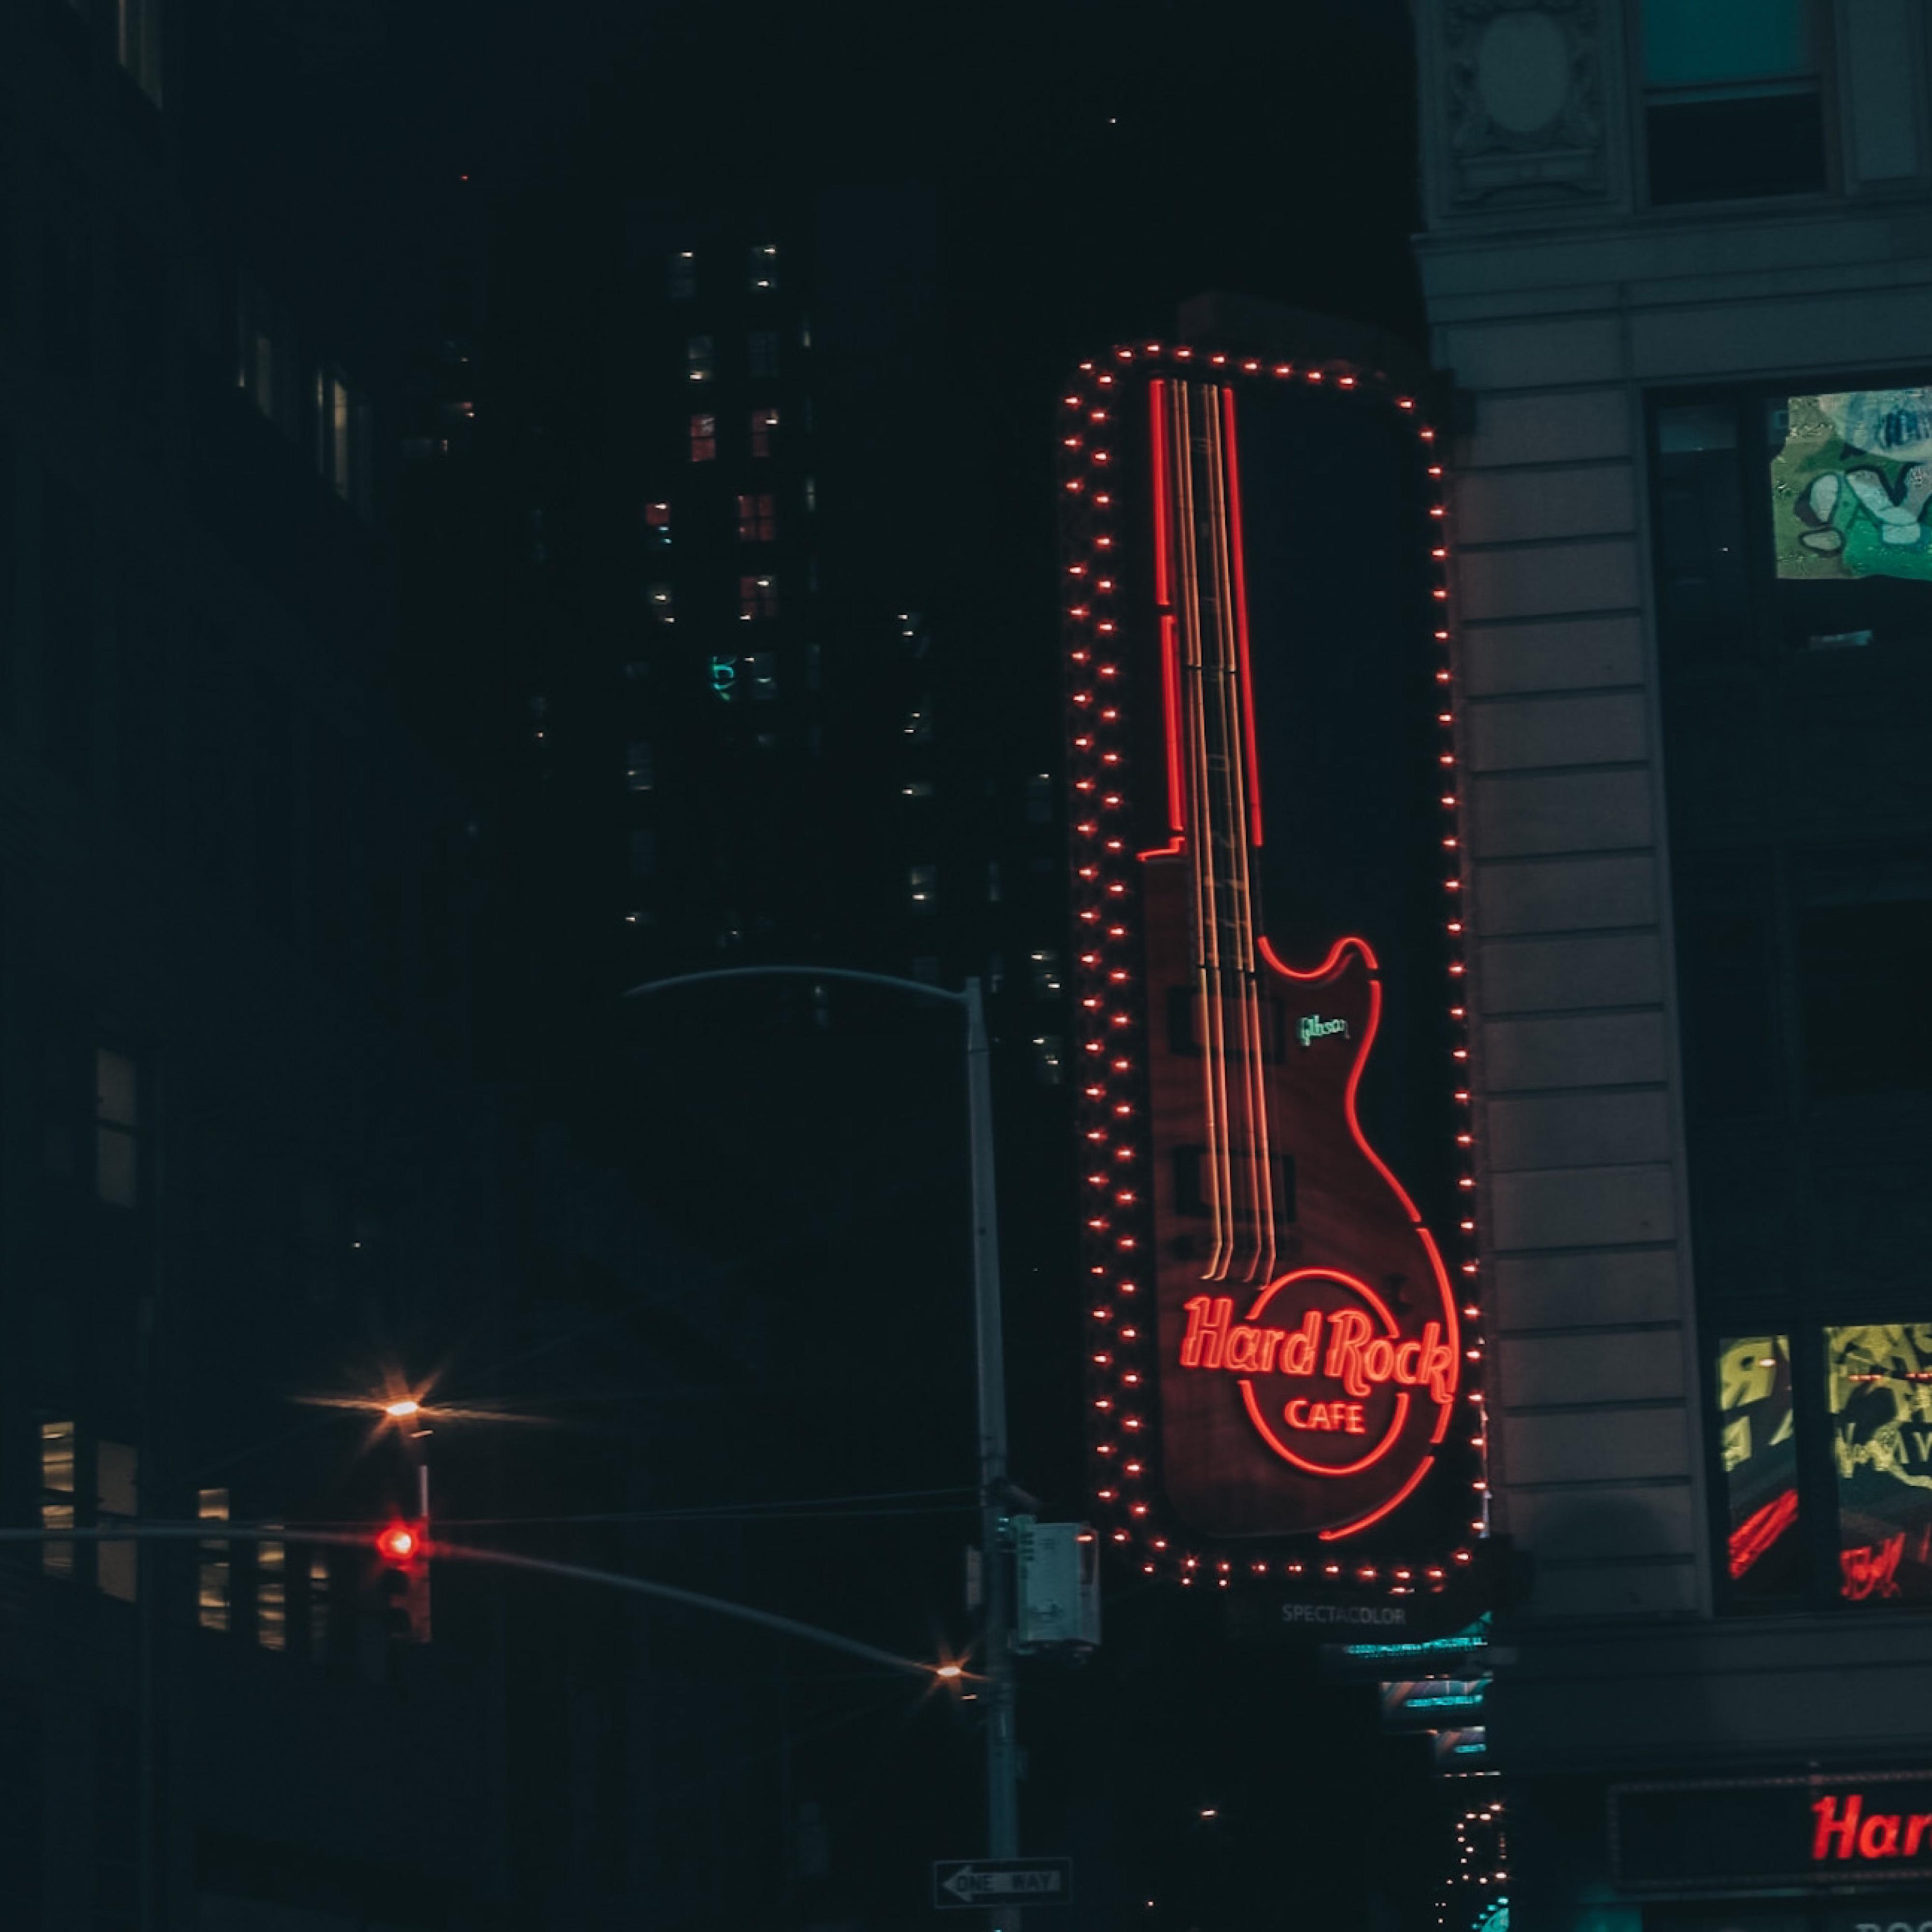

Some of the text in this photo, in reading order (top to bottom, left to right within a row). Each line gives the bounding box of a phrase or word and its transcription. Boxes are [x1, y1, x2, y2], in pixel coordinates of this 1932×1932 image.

[1179, 1296, 1456, 1405] Hard Rock
[1283, 1398, 1367, 1435] CAFE
[1281, 1603, 1407, 1626] SPECTACOLOR
[1810, 1794, 1932, 1860] Har
[956, 1870, 1053, 1894] ONE WAY
